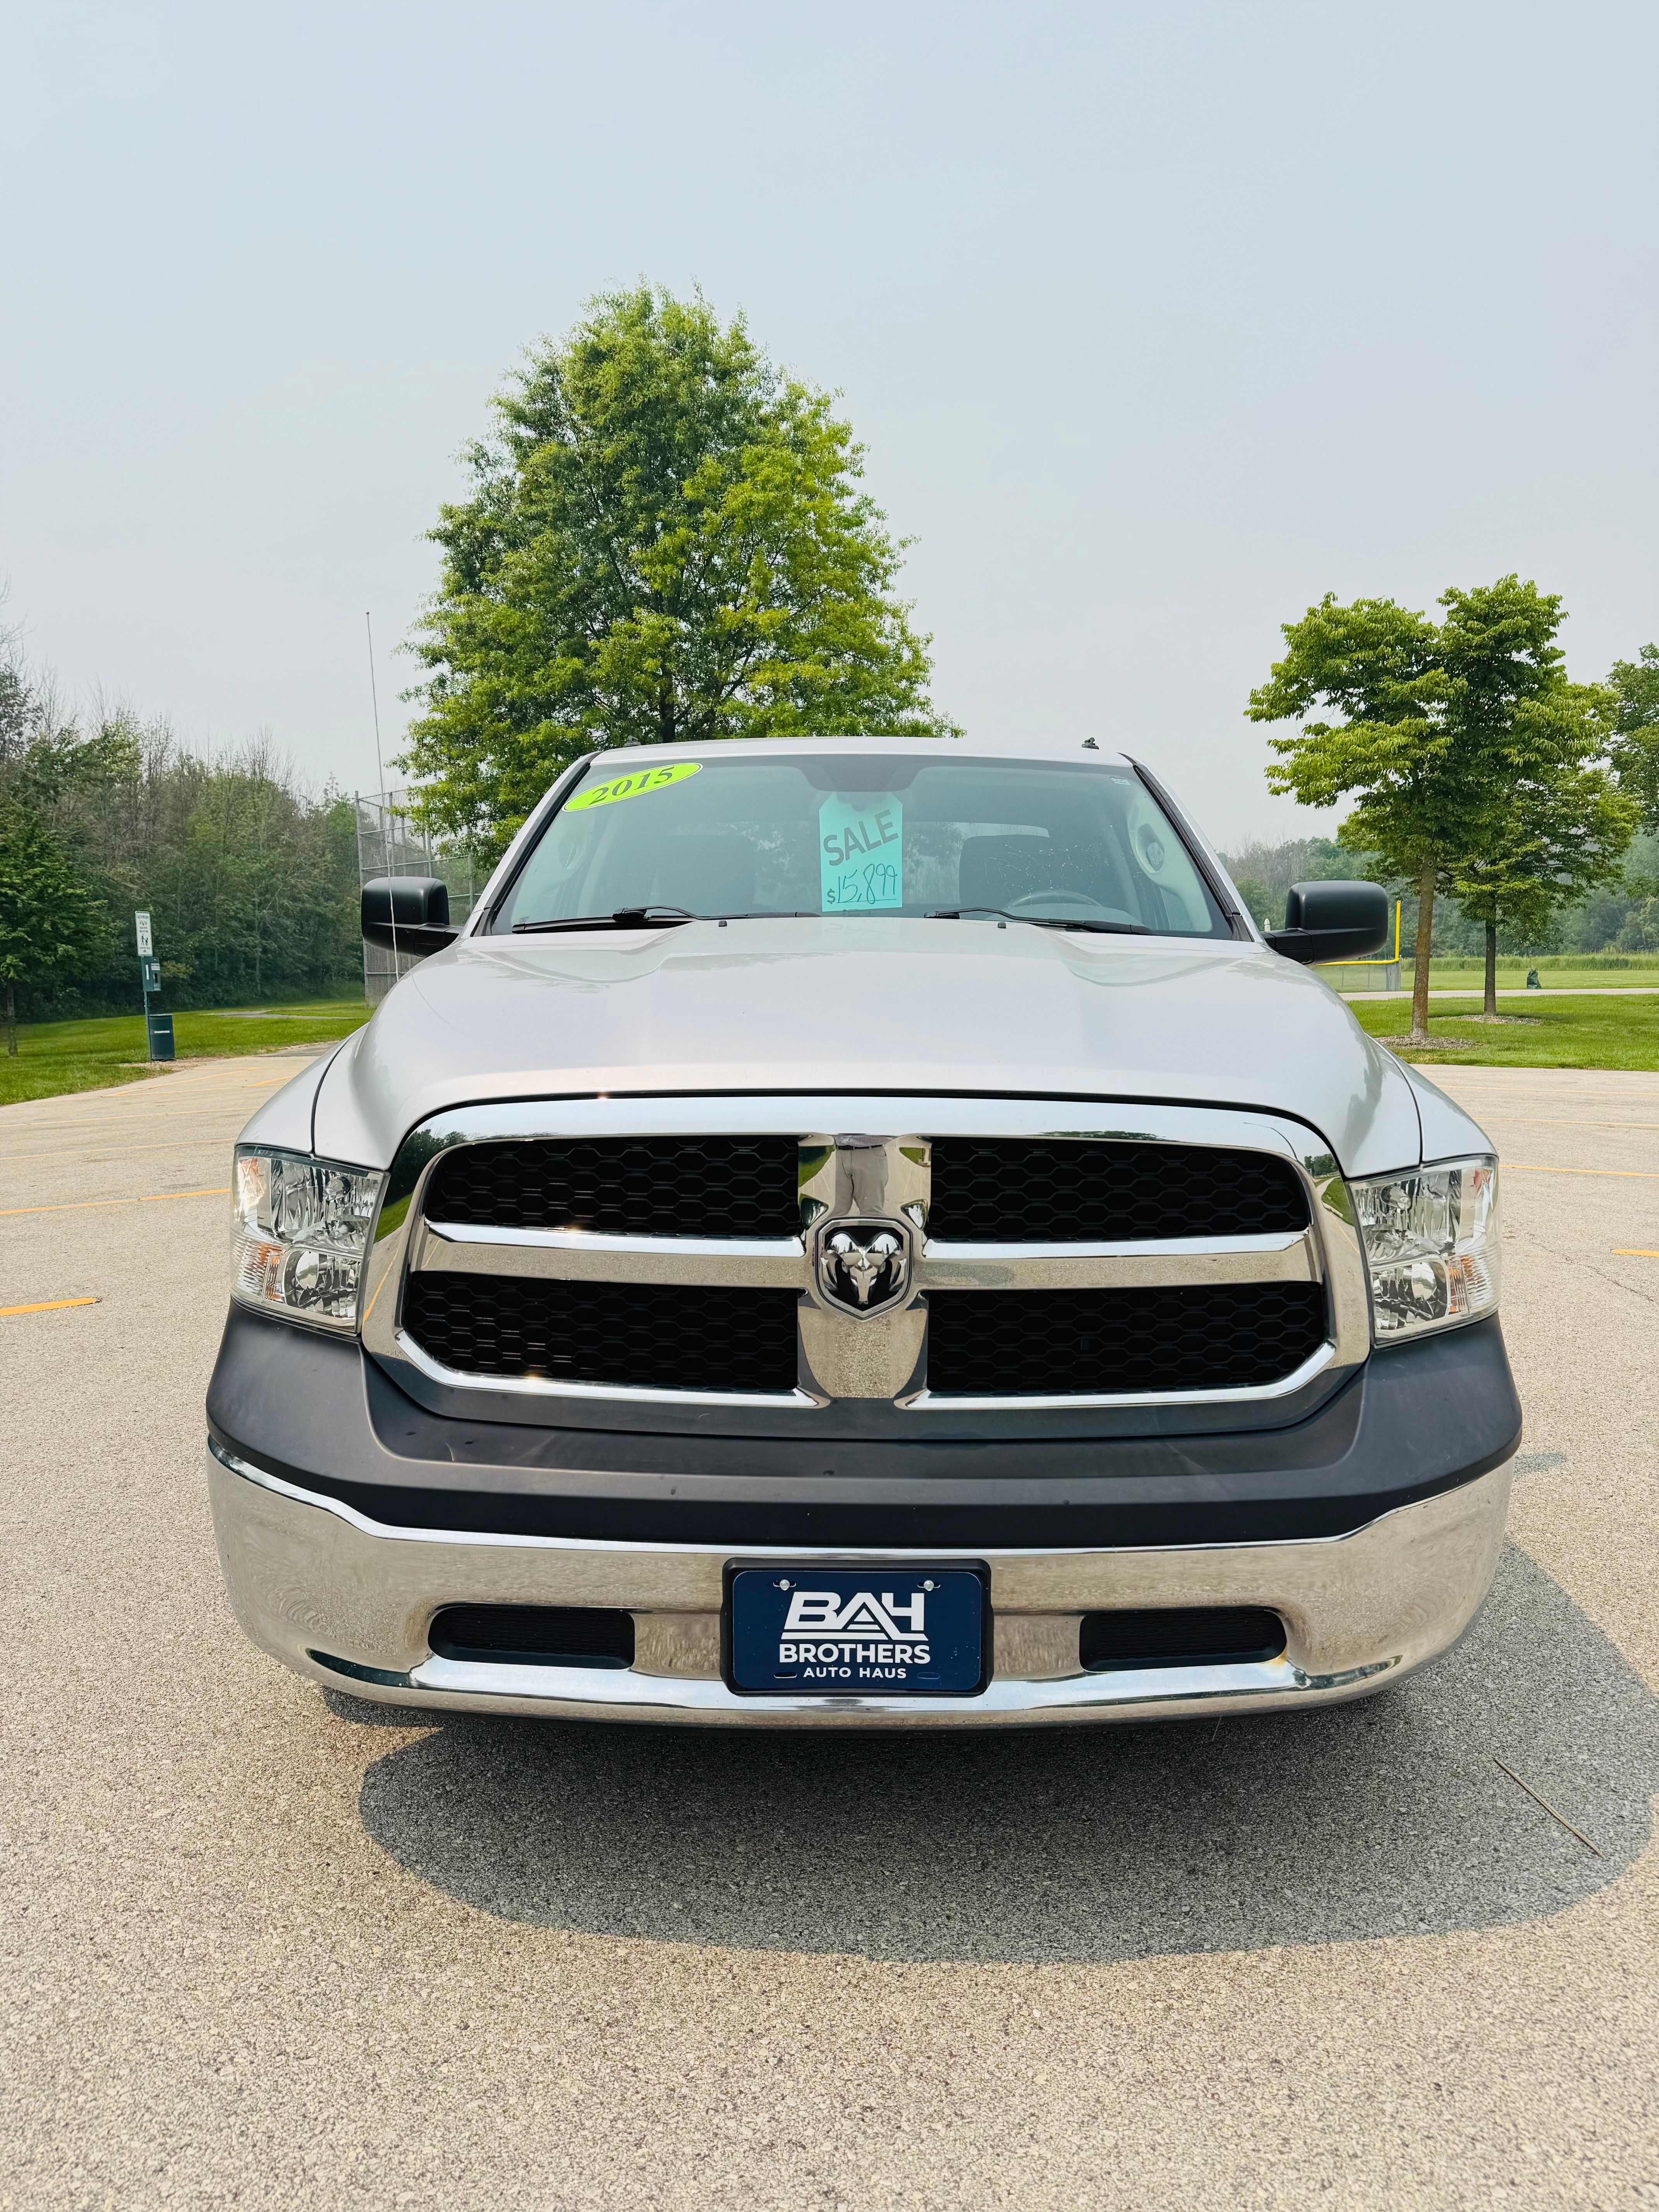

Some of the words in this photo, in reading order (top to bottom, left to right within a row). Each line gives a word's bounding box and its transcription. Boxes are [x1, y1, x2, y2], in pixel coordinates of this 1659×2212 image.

[588, 766, 675, 806] 2015
[823, 809, 898, 866] SALE
[784, 1592, 928, 1640] BAH
[779, 1643, 930, 1664] BROTHERS
[803, 1667, 851, 1678] AUTO
[859, 1667, 907, 1678] HAUS
